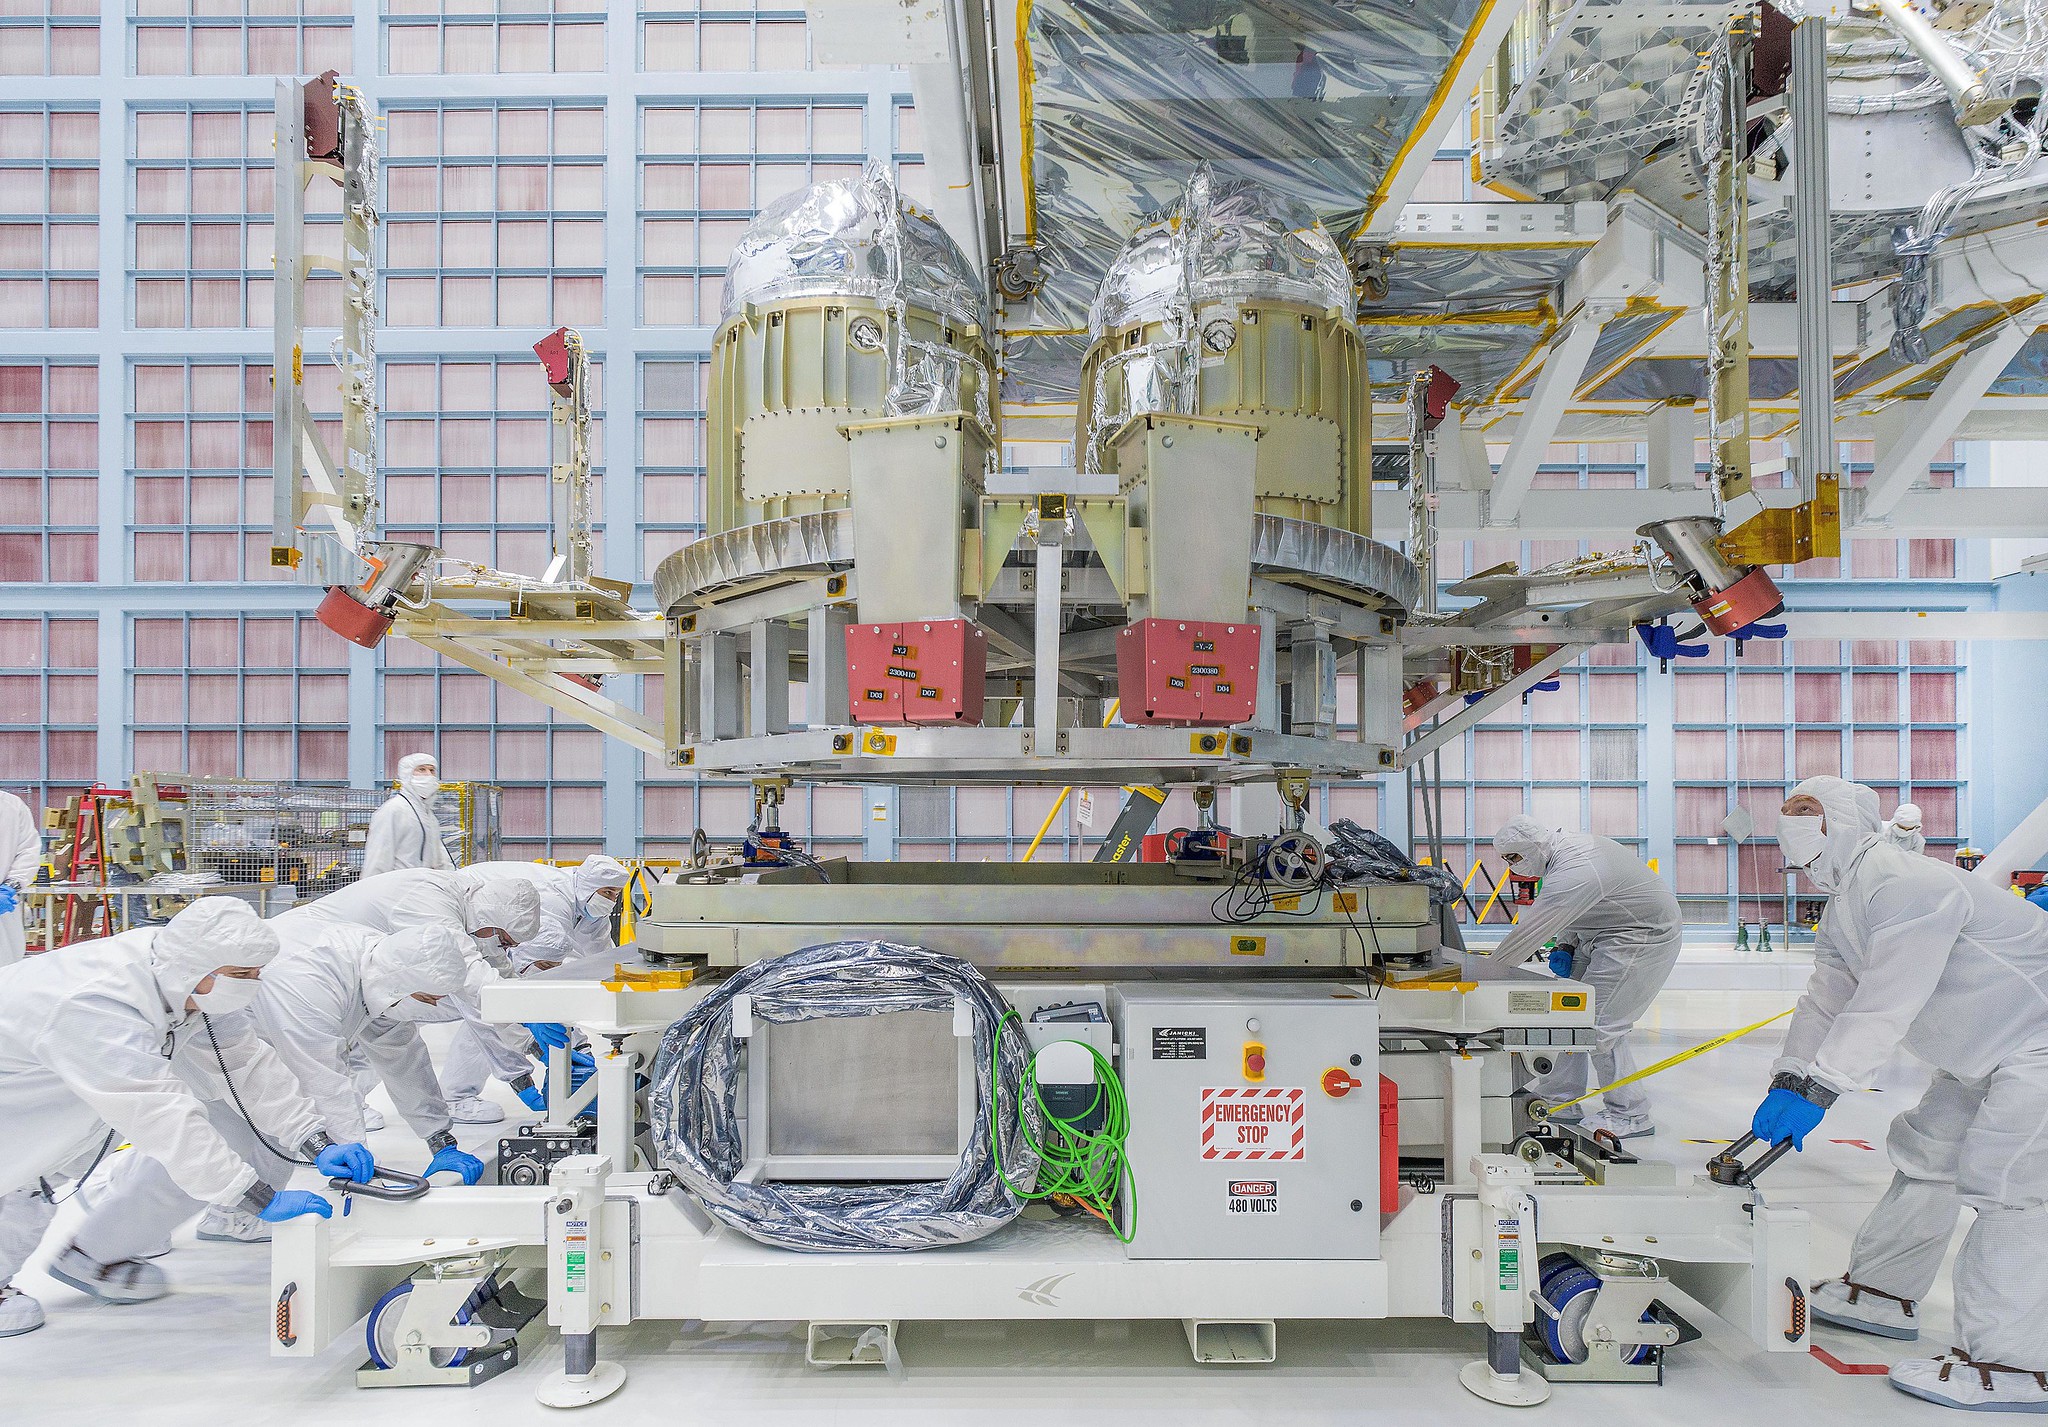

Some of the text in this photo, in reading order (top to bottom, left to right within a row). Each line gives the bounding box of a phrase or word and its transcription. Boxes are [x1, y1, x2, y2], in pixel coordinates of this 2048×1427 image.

[889, 668, 916, 679] 2300410
[922, 689, 935, 697] D07
[1217, 685, 1230, 693] D04
[869, 691, 883, 699] D03
[1215, 1104, 1291, 1122] EMERGENCY
[1237, 1126, 1269, 1143] STOP
[1234, 1184, 1272, 1193] DANGER
[1229, 1199, 1277, 1212] 480 VOLTS
